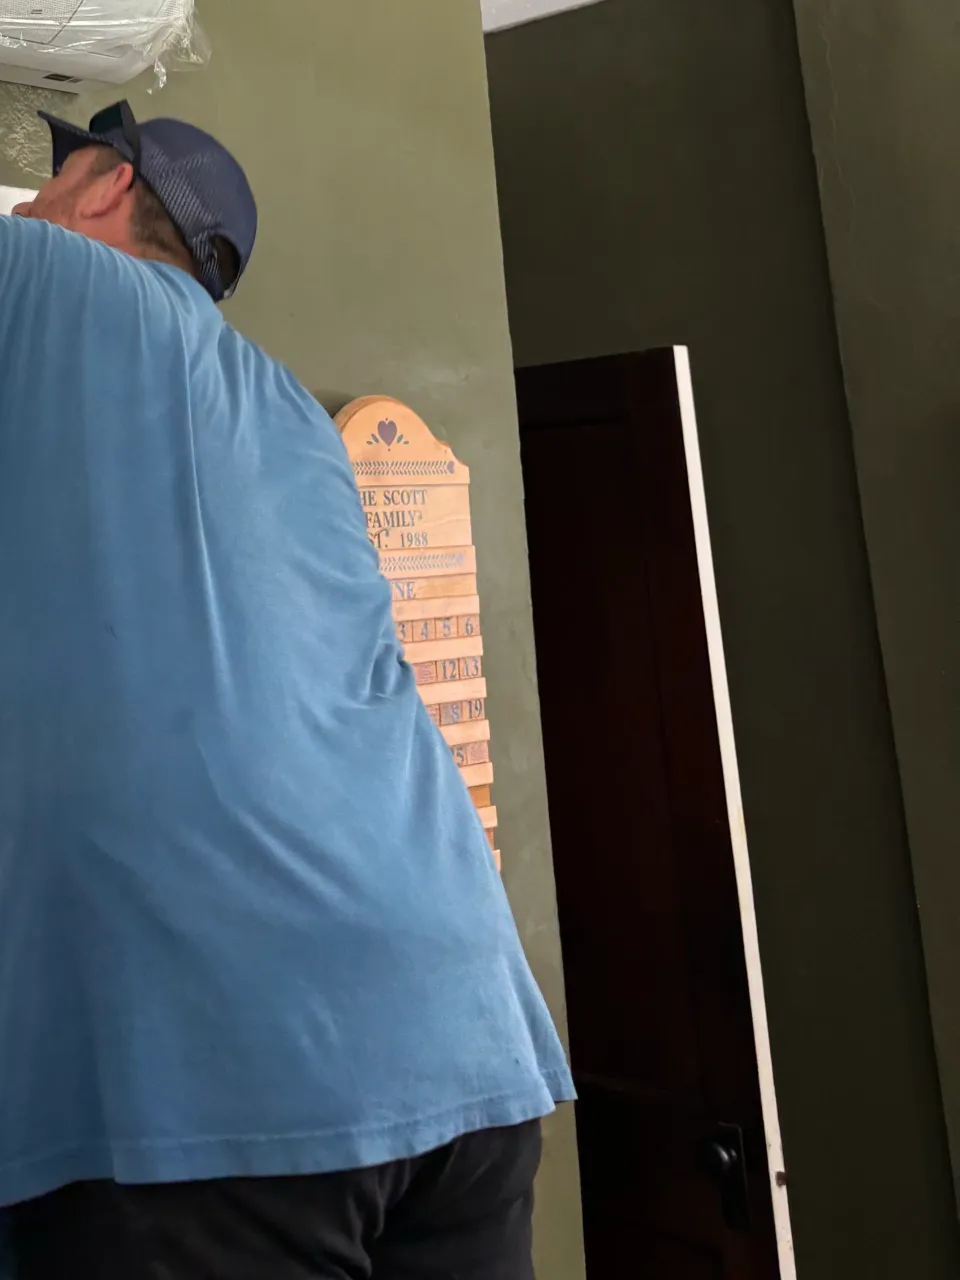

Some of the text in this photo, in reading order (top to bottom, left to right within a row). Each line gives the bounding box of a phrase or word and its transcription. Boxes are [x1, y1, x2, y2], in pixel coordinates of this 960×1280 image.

[383, 489, 427, 506] SCOTT
[365, 510, 417, 528] FAMILY
[400, 531, 428, 548] 1988
[421, 620, 429, 640] 4
[442, 617, 452, 638] 5
[465, 617, 474, 636] 6
[441, 656, 479, 680] 12 13
[468, 699, 483, 719] 19
